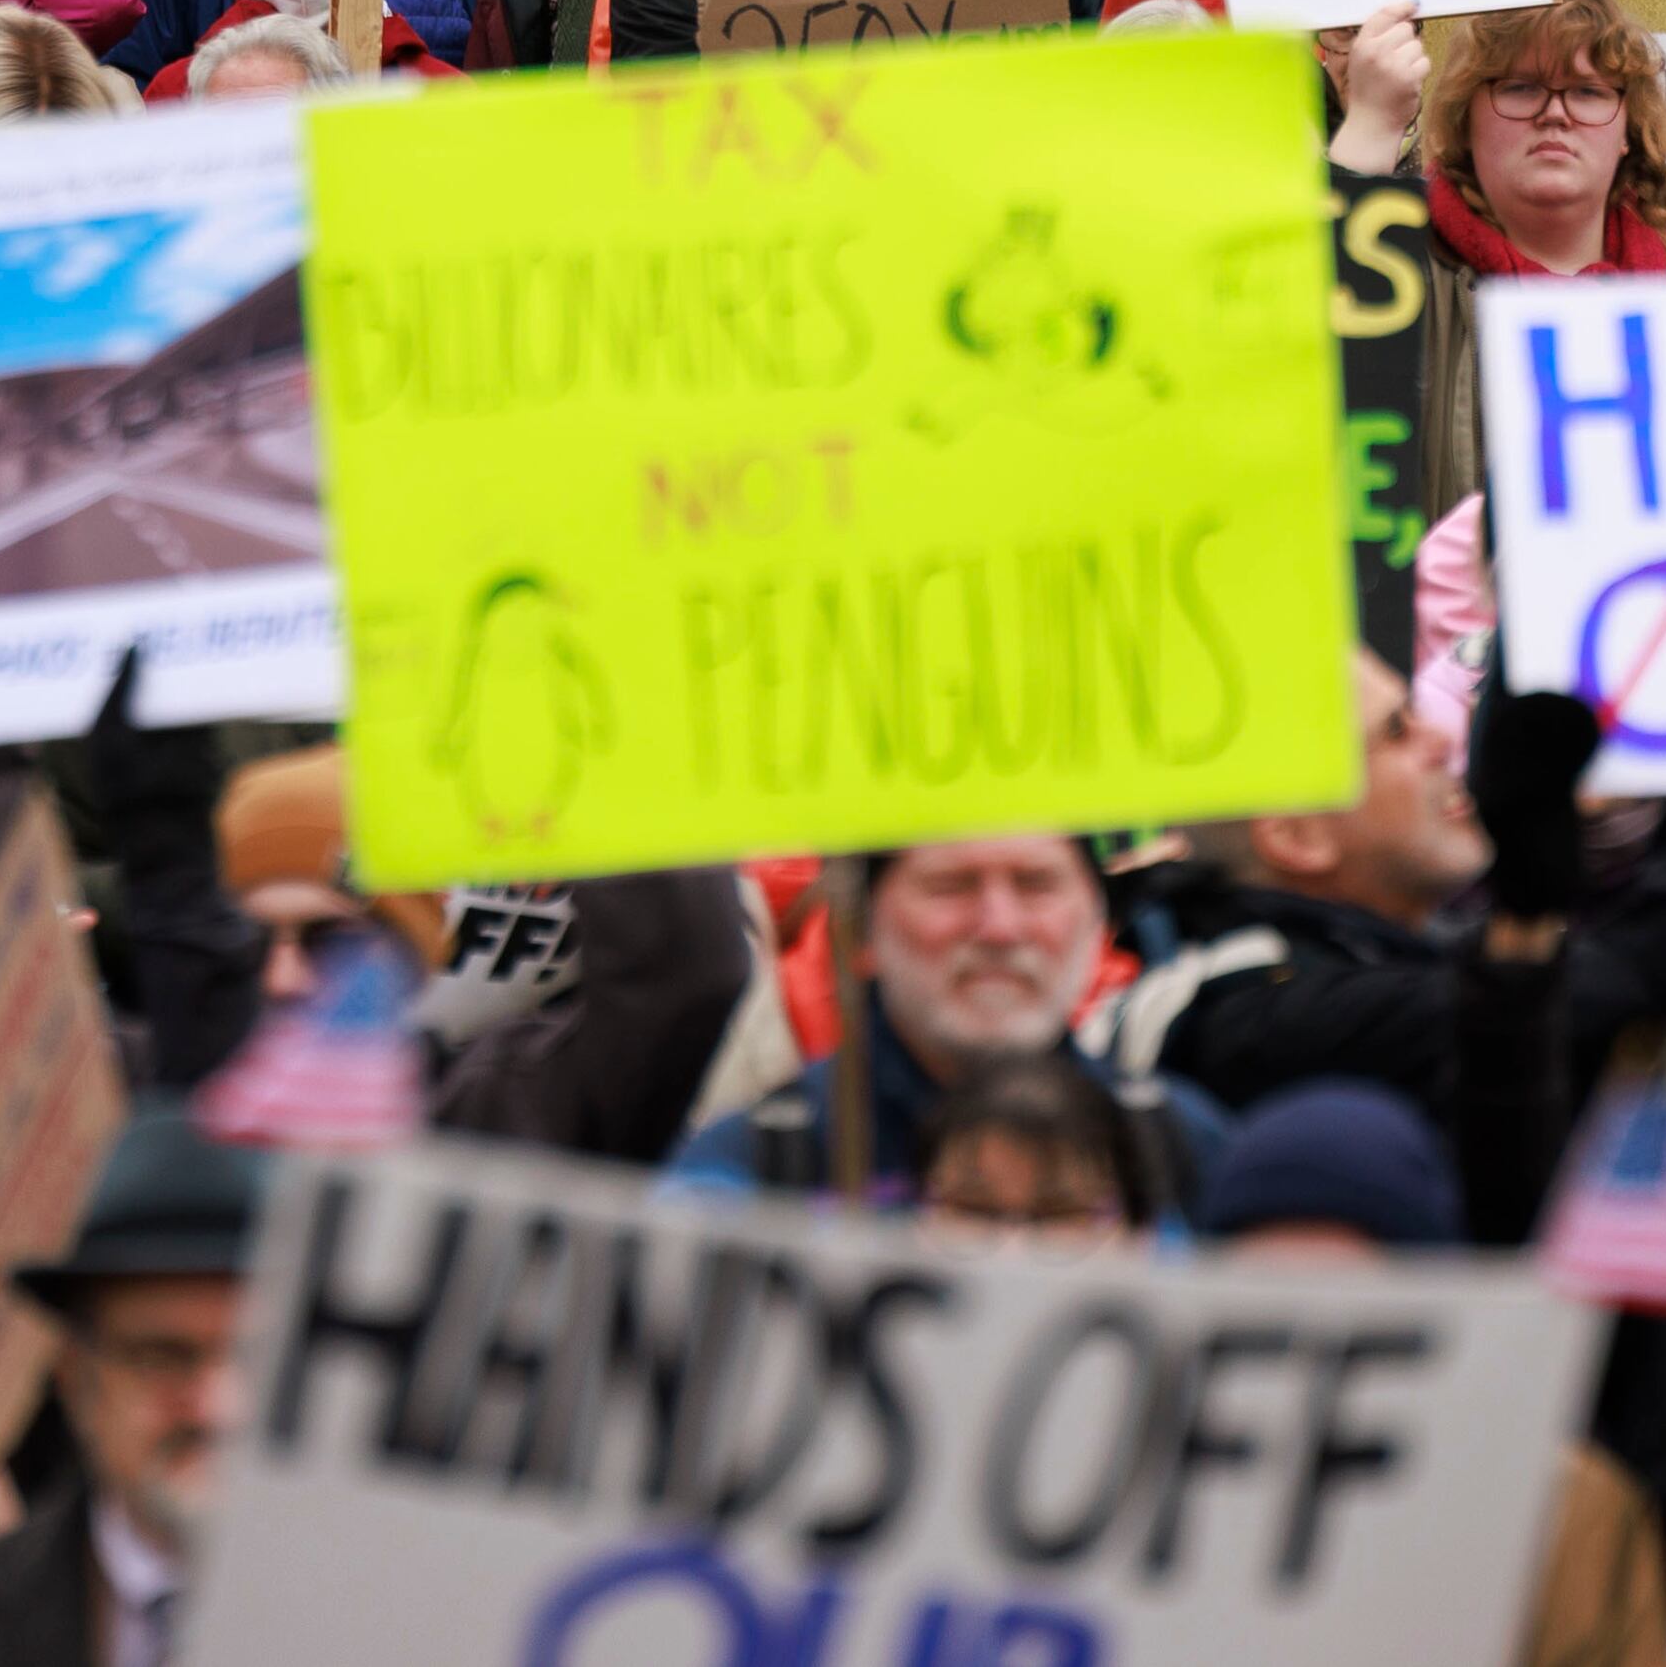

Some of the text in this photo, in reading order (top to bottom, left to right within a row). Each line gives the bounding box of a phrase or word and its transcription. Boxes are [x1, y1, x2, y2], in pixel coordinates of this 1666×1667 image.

[606, 75, 880, 194] TAX
[641, 437, 858, 547] NOT
[678, 504, 1249, 796] PENGUINS
[269, 1177, 1443, 1601] HANDS OFF
